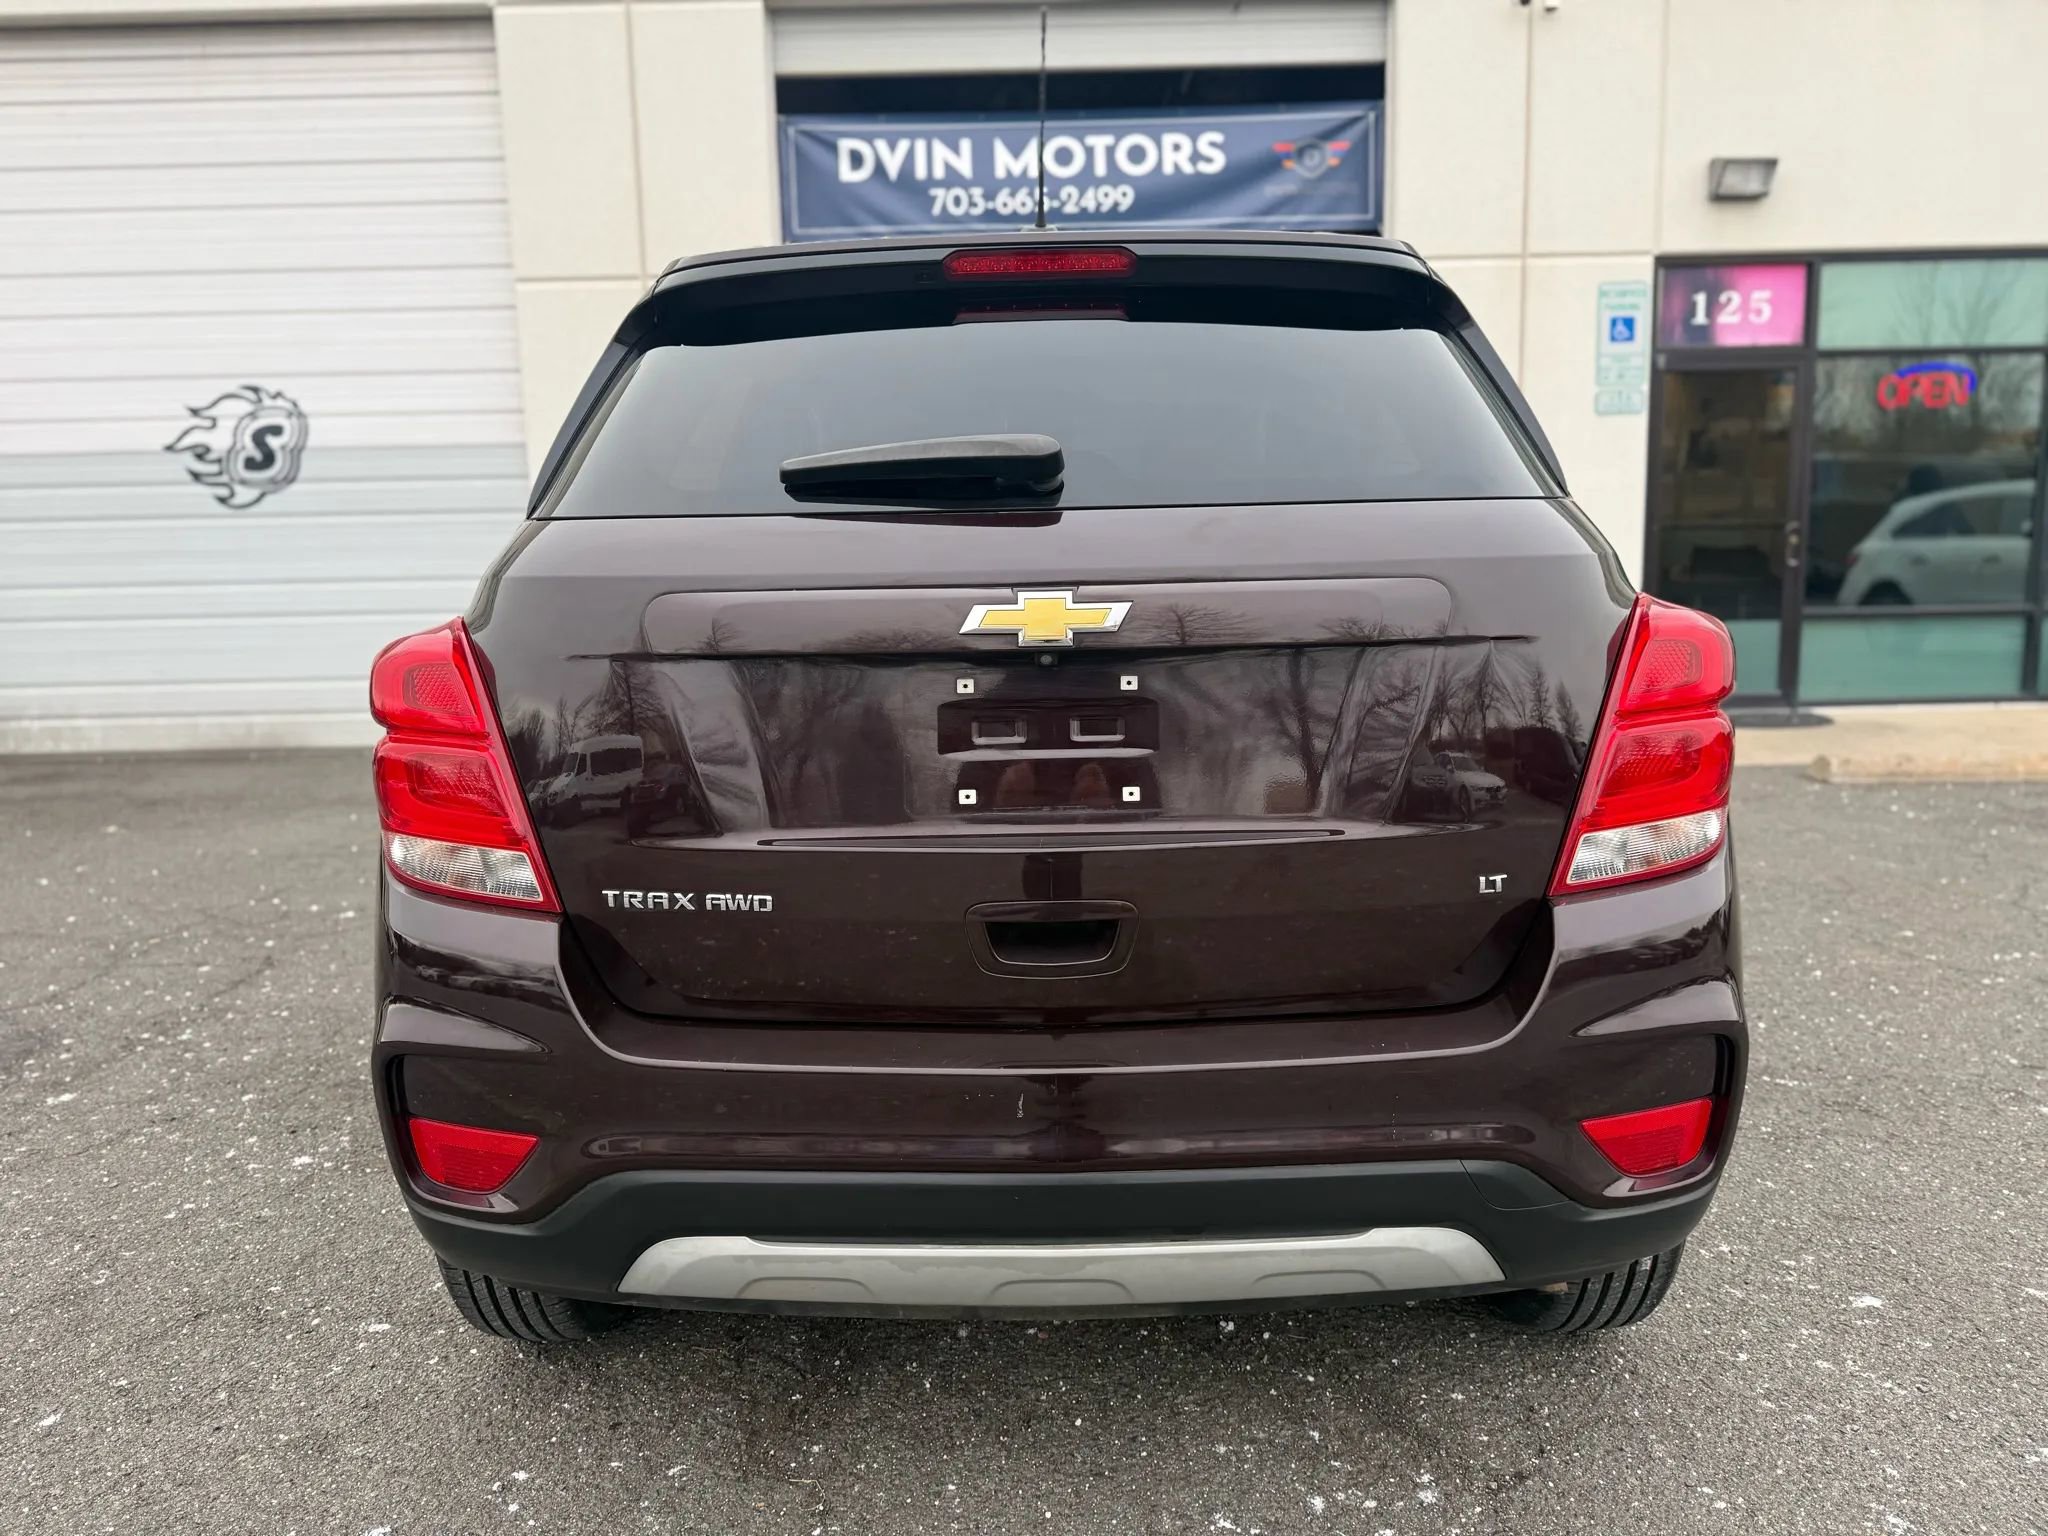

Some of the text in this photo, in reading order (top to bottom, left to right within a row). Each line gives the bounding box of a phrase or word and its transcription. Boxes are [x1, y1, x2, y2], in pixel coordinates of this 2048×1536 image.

[837, 132, 1226, 182] DVIN MOTORS
[928, 184, 1135, 216] 703-665-2499
[1691, 290, 1772, 325] 125
[1877, 371, 1970, 410] OPEN
[1479, 874, 1507, 893] LT
[602, 890, 773, 912] TRAX AWD
